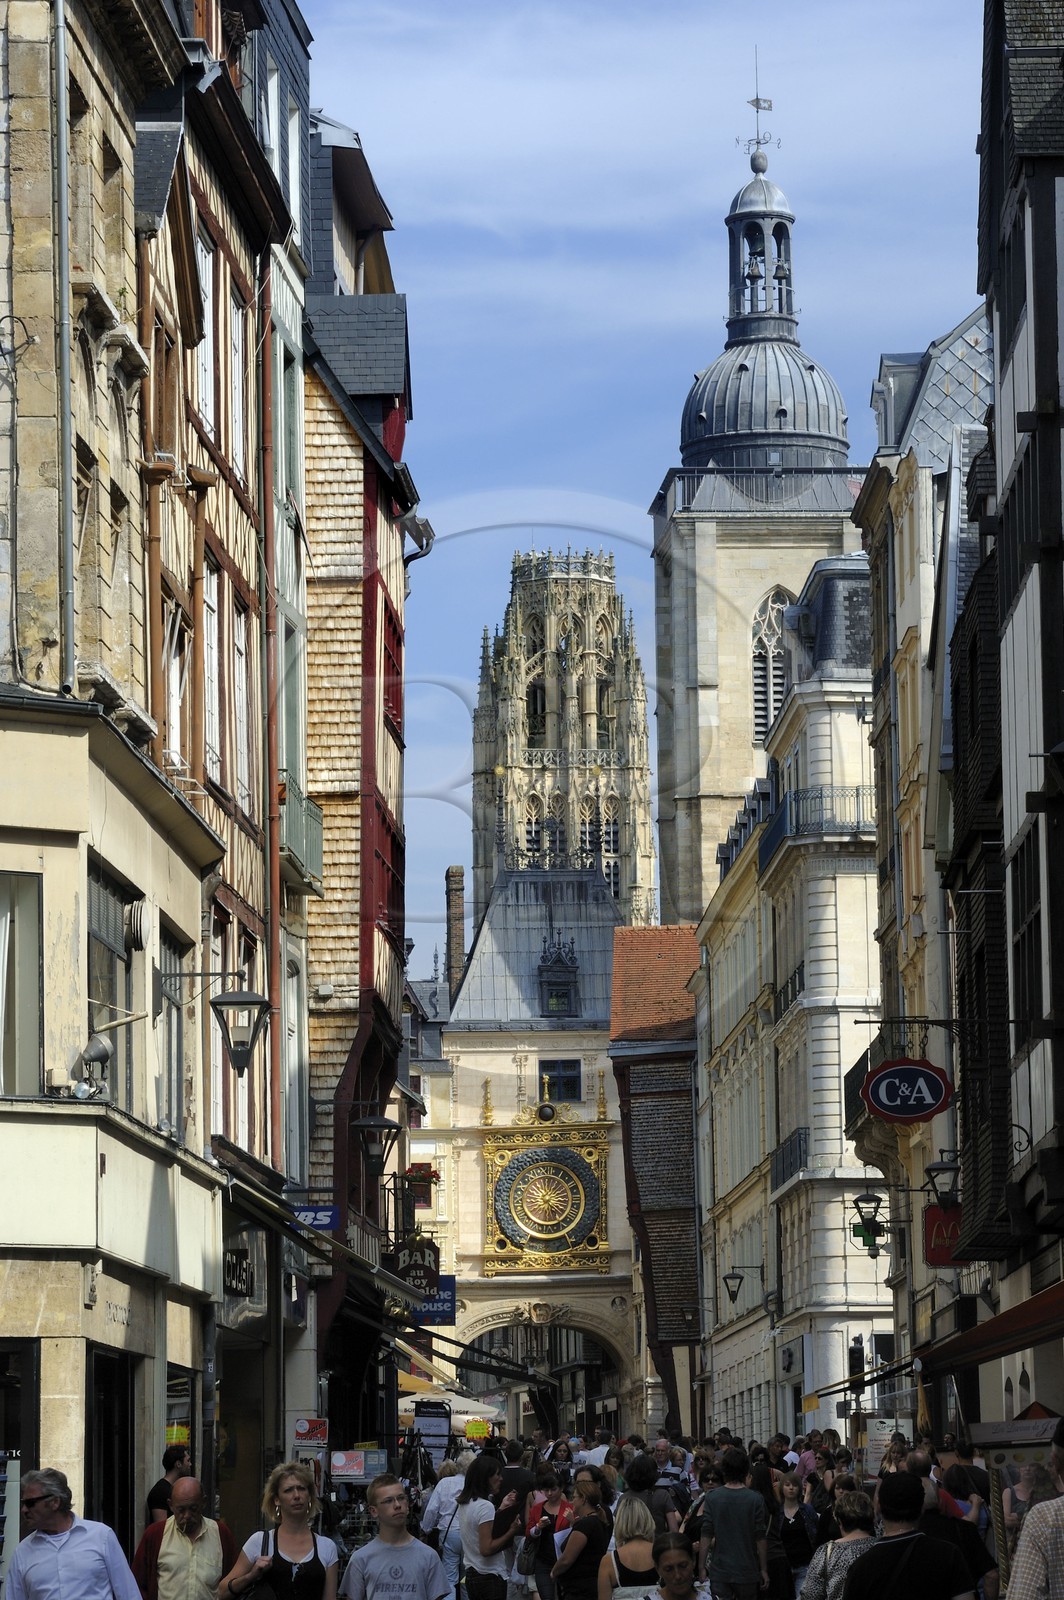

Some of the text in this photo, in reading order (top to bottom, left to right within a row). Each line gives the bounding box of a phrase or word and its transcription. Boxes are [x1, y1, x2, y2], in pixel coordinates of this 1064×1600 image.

[878, 1077, 936, 1106] C&A
[398, 1248, 436, 1271] BAR
[410, 1269, 424, 1277] au
[405, 1276, 428, 1286] Roy
[375, 1583, 417, 1593] FIRENZE
